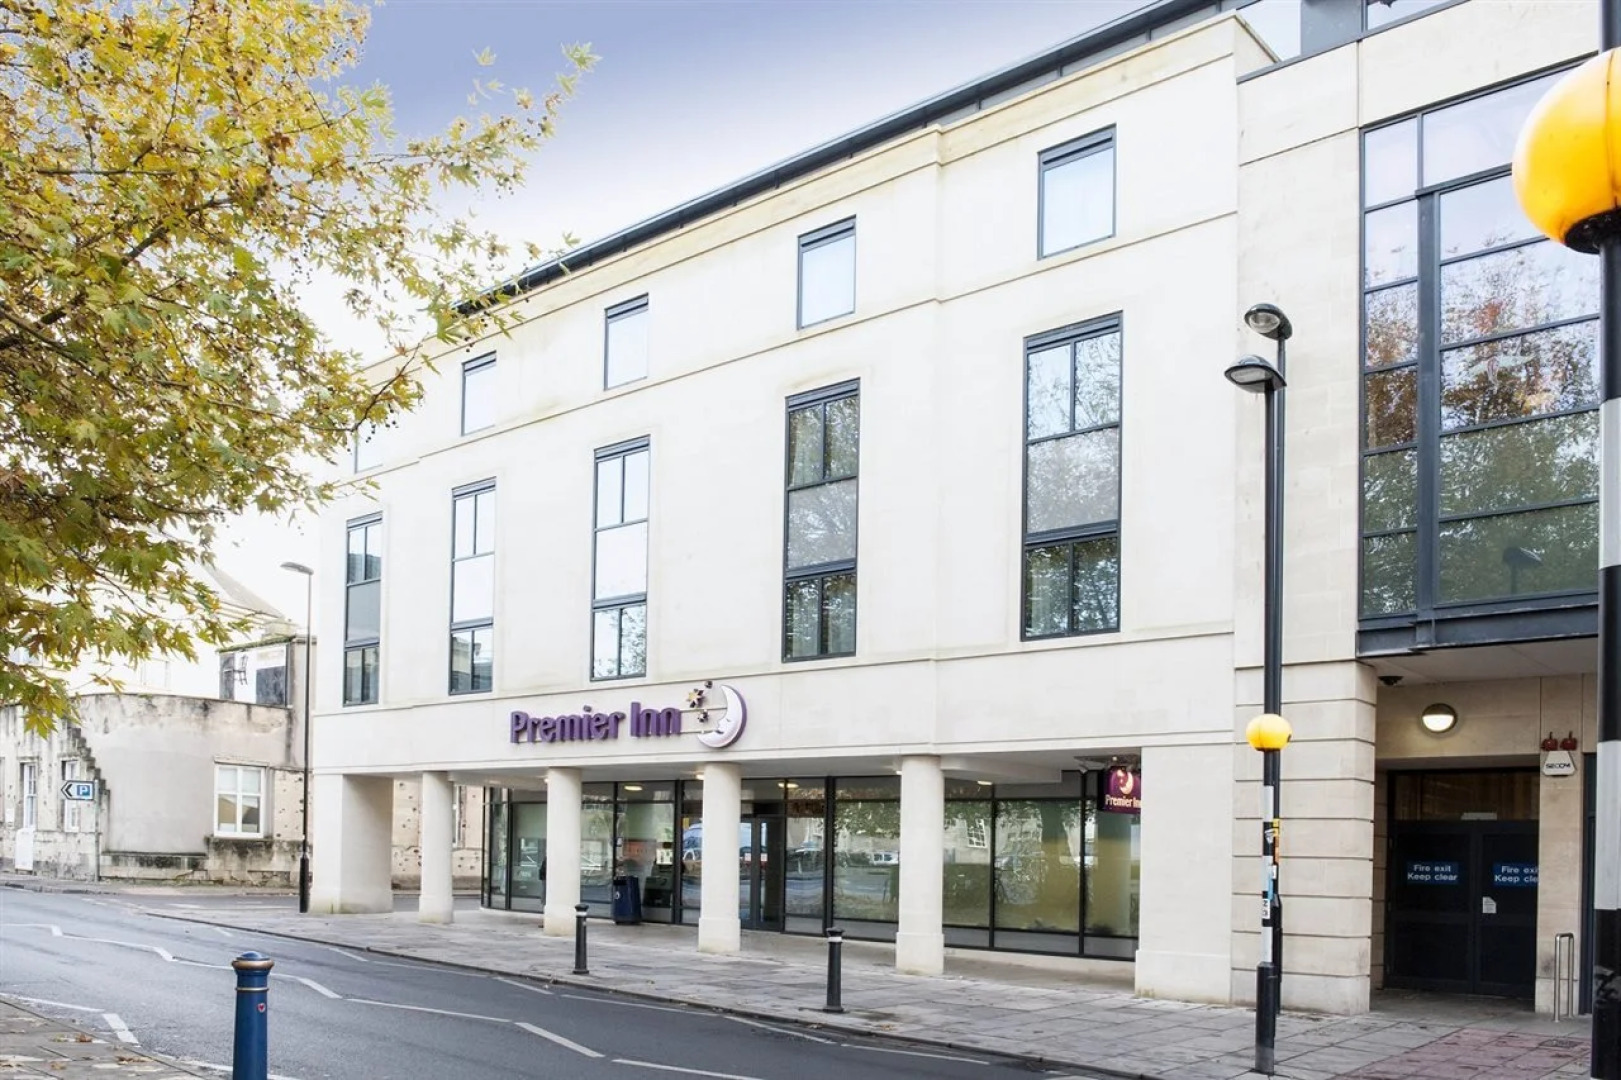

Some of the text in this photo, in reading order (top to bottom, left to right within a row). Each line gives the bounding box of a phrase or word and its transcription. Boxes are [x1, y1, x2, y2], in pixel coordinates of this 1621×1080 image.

[510, 701, 682, 744] Premier Inn
[79, 785, 88, 796] P
[1105, 794, 1132, 808] Premier
[1413, 864, 1431, 872] Fire
[1501, 865, 1520, 873] Fire
[1407, 872, 1458, 881] Keep clear
[1494, 874, 1539, 884] Keep cle
